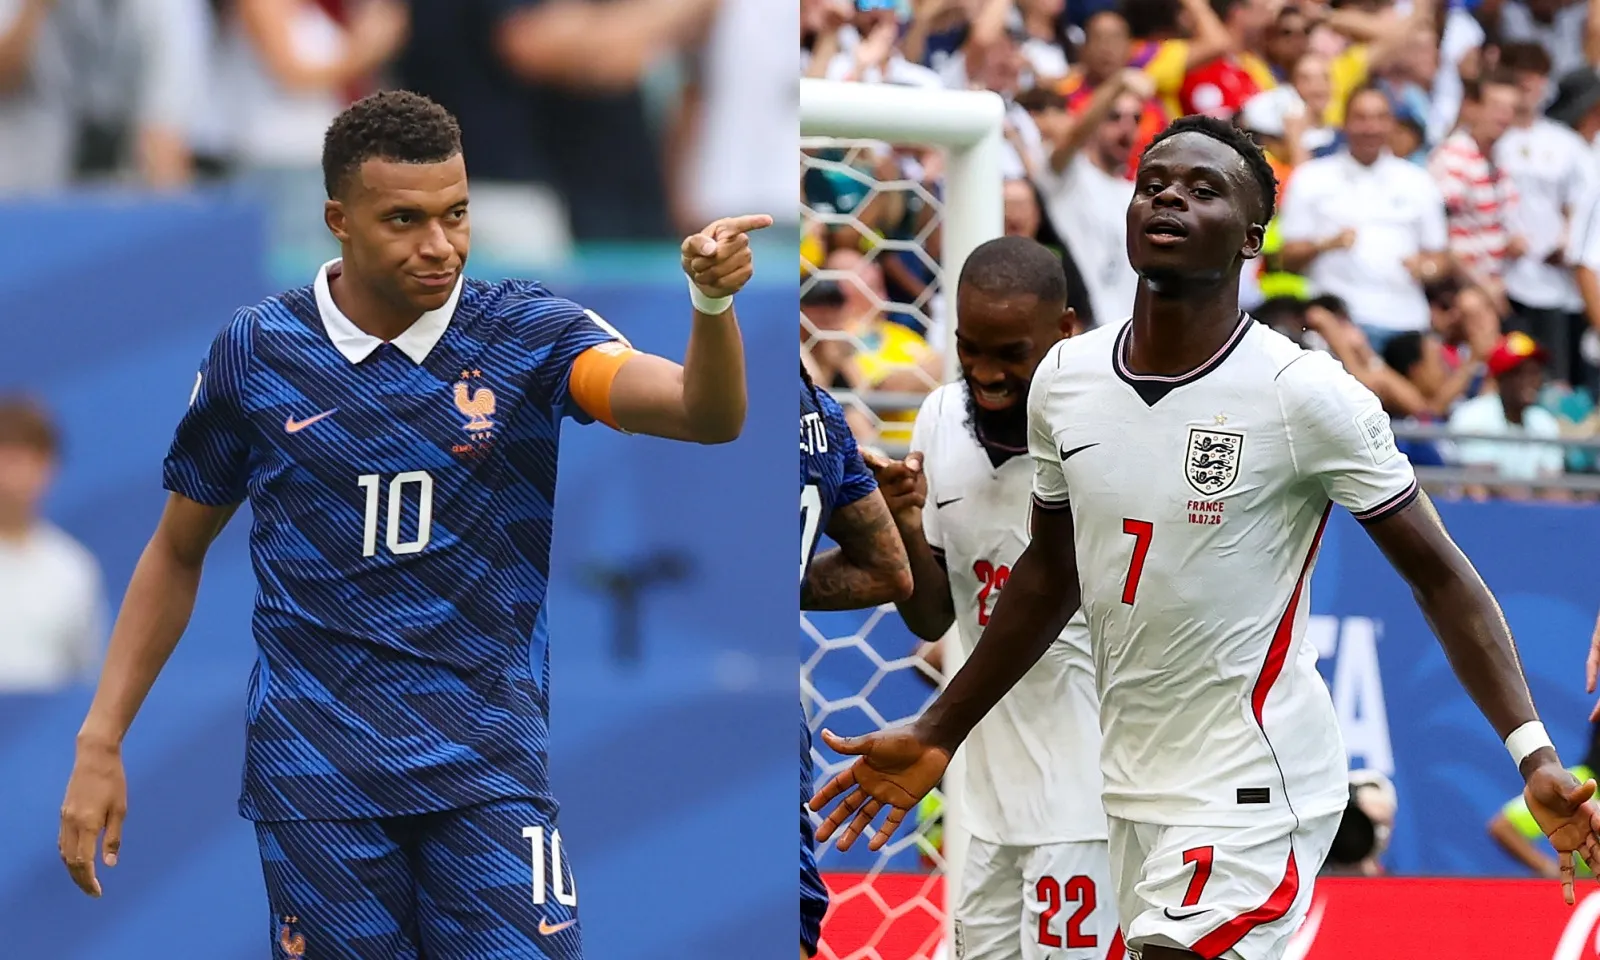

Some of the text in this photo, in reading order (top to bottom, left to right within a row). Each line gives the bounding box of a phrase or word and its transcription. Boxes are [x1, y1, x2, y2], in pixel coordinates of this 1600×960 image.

[358, 470, 433, 557] 10
[1187, 500, 1225, 512] FRANCE
[1121, 517, 1154, 606] 7
[522, 826, 577, 907] 10
[1182, 845, 1214, 907] 7
[1036, 875, 1098, 949] 22
